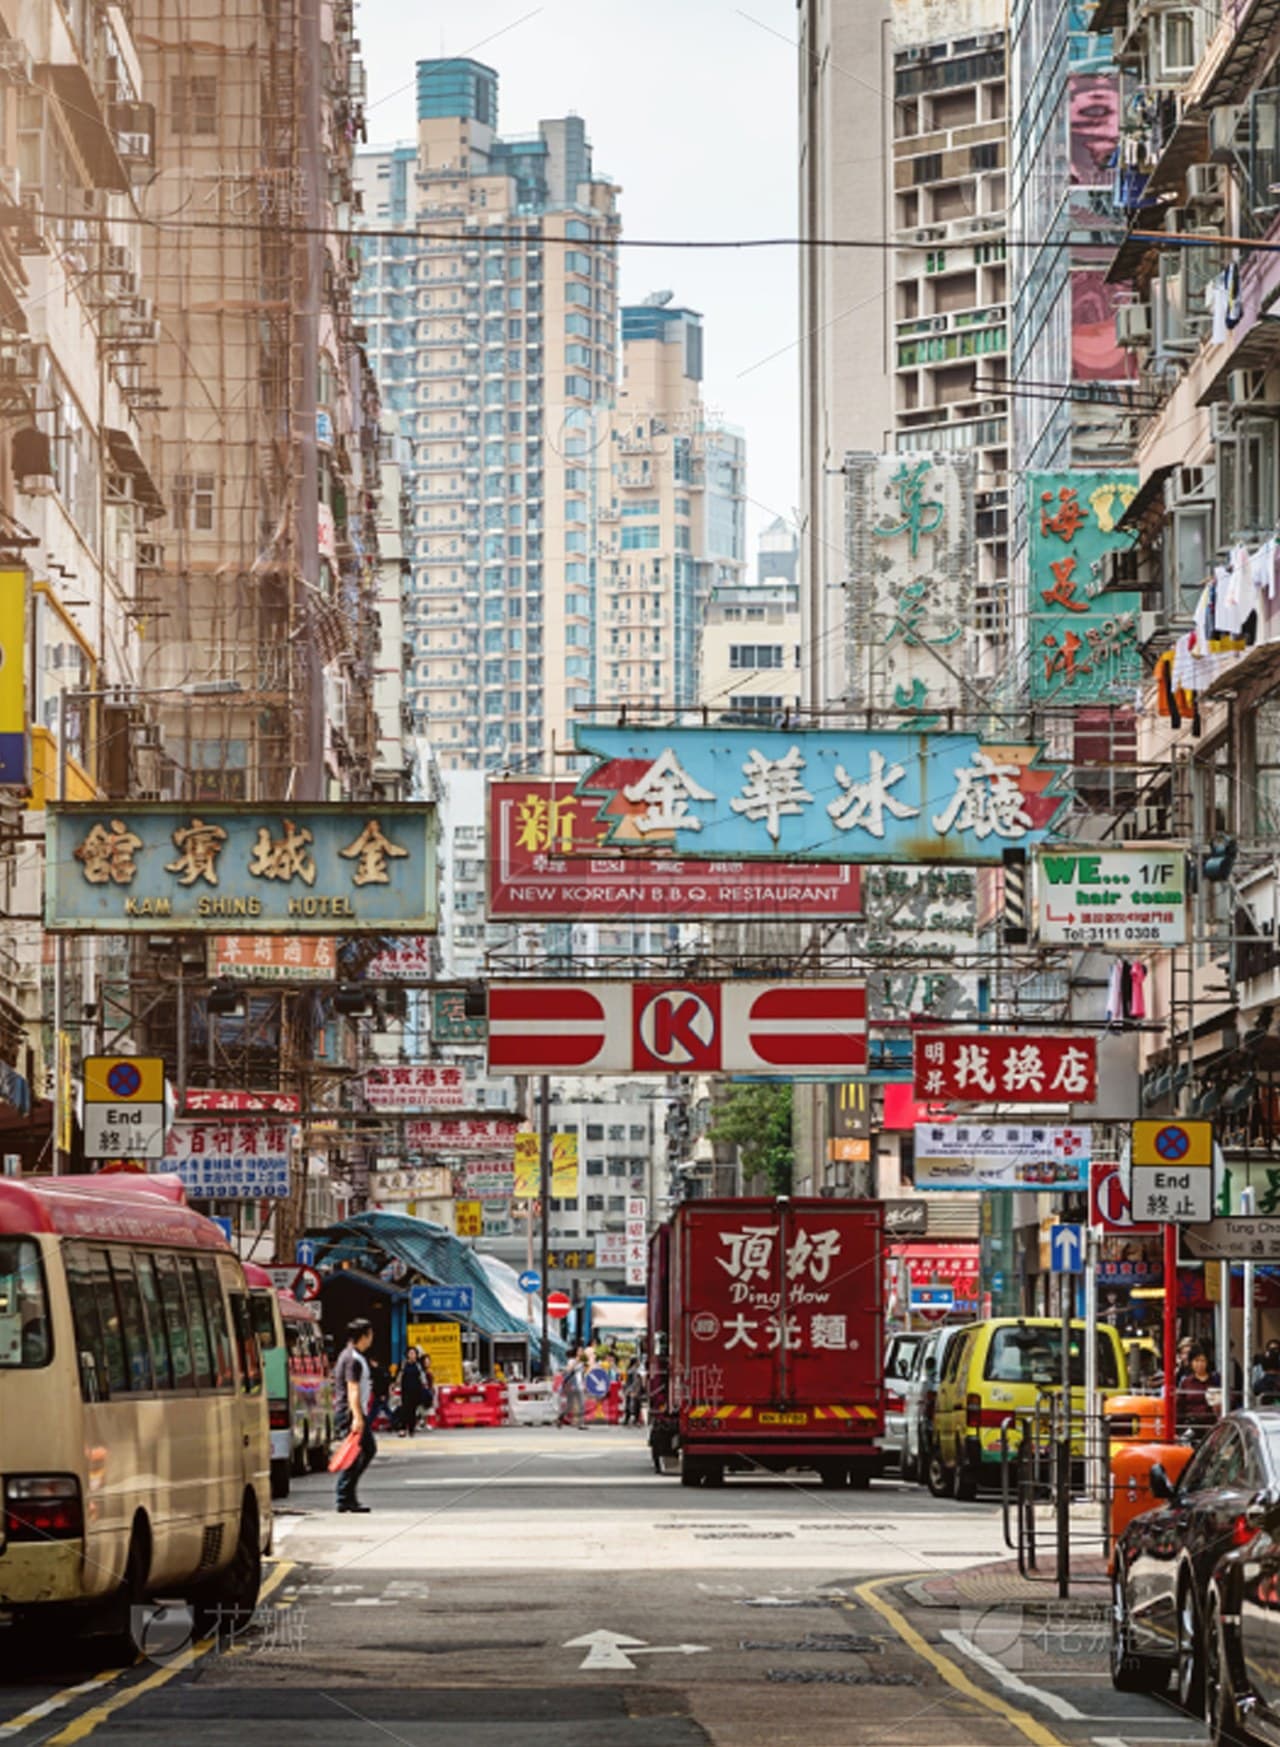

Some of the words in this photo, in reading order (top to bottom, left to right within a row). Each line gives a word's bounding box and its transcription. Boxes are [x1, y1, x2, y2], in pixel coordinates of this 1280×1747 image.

[623, 744, 1033, 840] 金華冰廳
[1043, 856, 1130, 884] WE...
[1139, 864, 1175, 884] 1/F
[509, 886, 559, 901] NEW
[562, 886, 646, 901] KOREAN
[651, 886, 712, 903] B.B.Q.
[718, 885, 840, 901] RESTAURANT
[1076, 890, 1122, 905] hair
[1131, 890, 1182, 905] team
[125, 896, 172, 918] KAM
[198, 896, 261, 918] SHING
[288, 896, 356, 918] HOTEL
[648, 996, 712, 1063] K
[953, 1043, 1090, 1094] 找換店
[107, 1109, 142, 1125] End
[99, 1129, 150, 1152] 終止
[1154, 1172, 1190, 1189] End
[1147, 1193, 1196, 1215] 終止
[1226, 1221, 1255, 1236] Tung
[715, 1225, 842, 1282] 頂好
[729, 1282, 782, 1312] Ding
[789, 1283, 830, 1303] How
[722, 1313, 848, 1350] 大光麵
